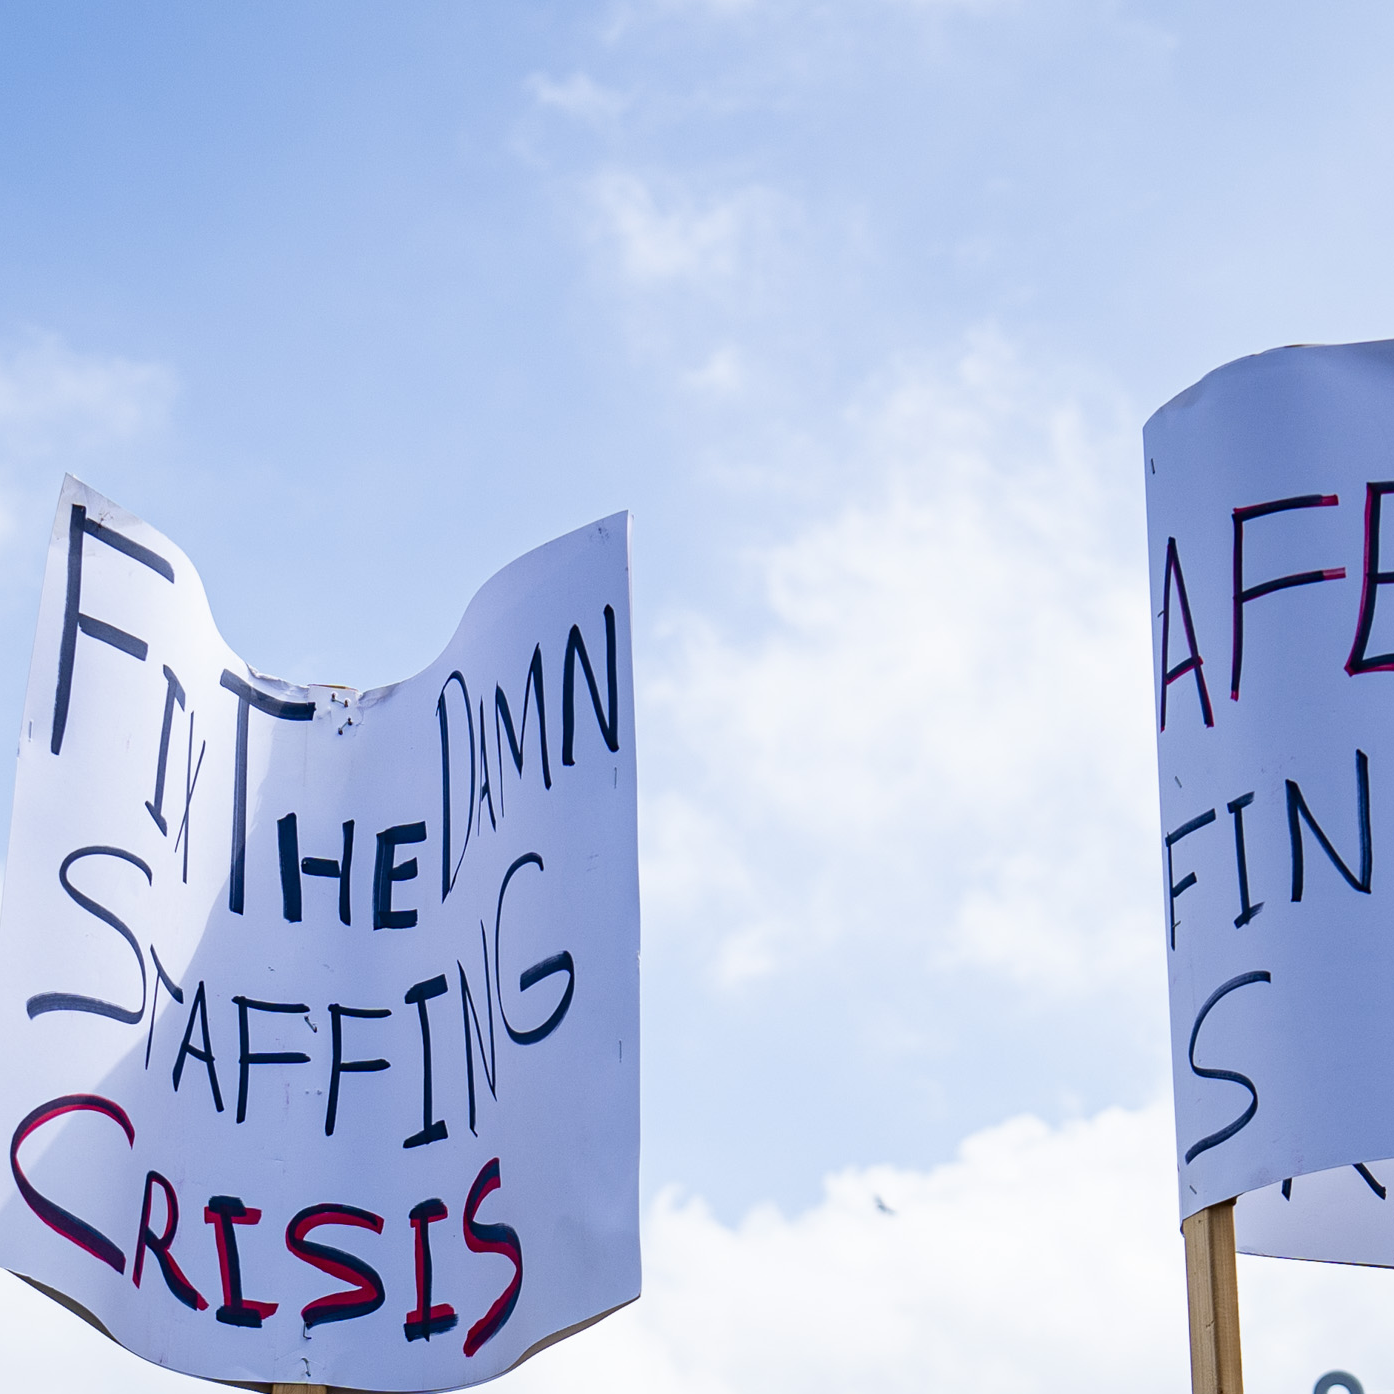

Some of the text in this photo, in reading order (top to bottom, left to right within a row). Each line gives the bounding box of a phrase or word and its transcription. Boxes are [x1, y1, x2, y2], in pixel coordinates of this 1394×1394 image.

[50, 503, 620, 931] FIX THE DAMN
[26, 844, 576, 1150] STAFFING
[1183, 969, 1273, 1166] S
[9, 1092, 524, 1358] CRISIS
